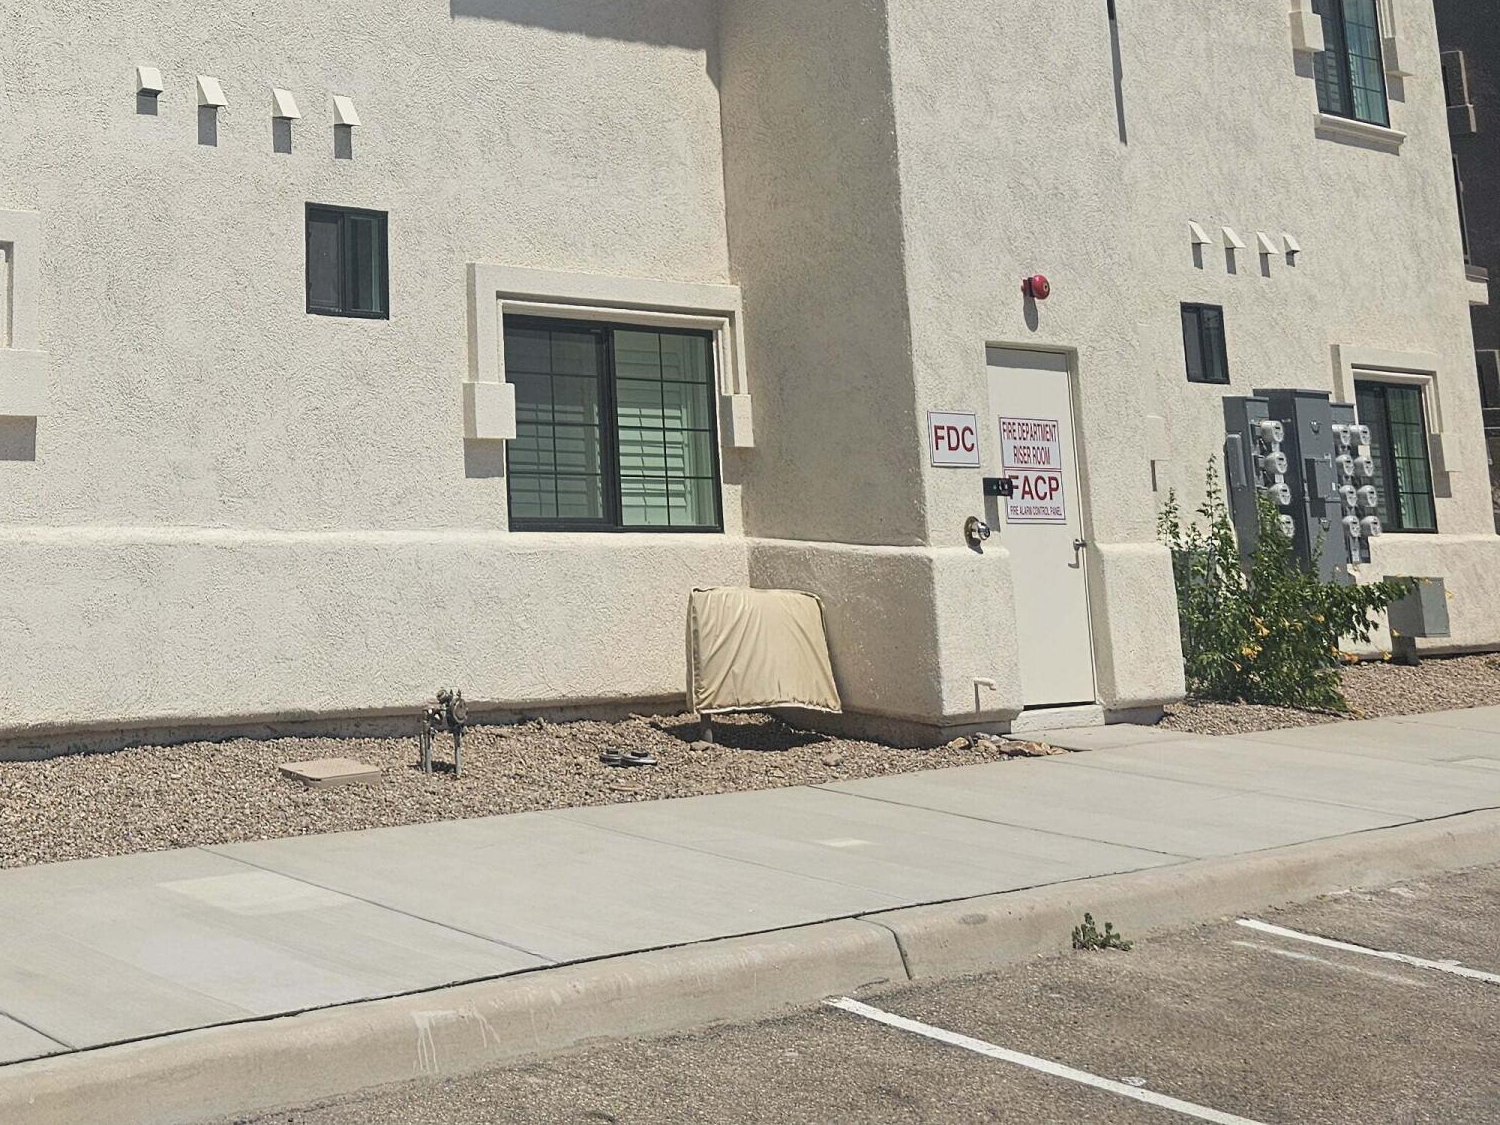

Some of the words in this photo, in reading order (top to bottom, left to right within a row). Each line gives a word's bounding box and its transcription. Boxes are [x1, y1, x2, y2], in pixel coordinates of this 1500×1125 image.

[933, 424, 975, 453] FDC
[1002, 421, 1017, 441] FIRE
[1017, 422, 1057, 443] DEPARTMENT
[1013, 445, 1032, 465] RISER
[1032, 446, 1051, 465] ROOM
[1008, 474, 1060, 501] FACP
